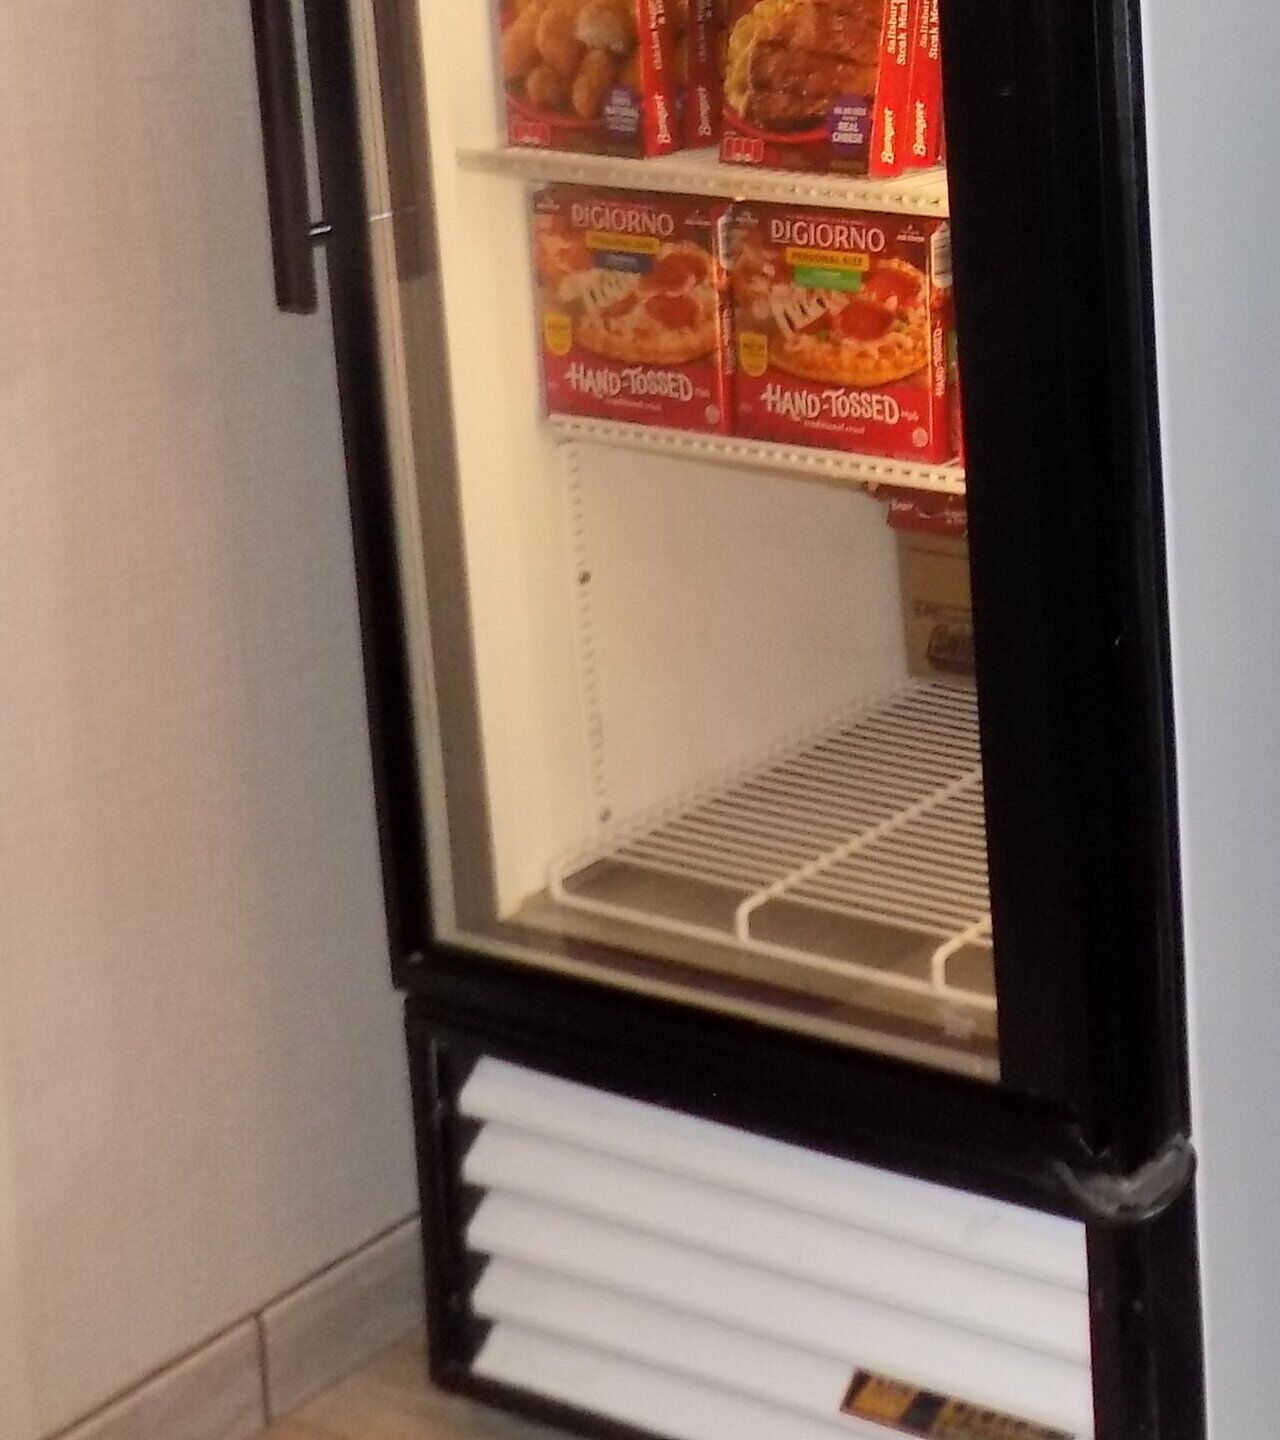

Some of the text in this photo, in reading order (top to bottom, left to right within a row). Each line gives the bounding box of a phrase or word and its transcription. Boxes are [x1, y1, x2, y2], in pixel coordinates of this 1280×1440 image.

[897, 32, 907, 66] Steak
[928, 25, 938, 60] Steak
[655, 93, 672, 144] Banquet
[881, 106, 897, 164] Banquet
[913, 99, 927, 157] Banquet
[564, 361, 695, 402] HAND-TOSSED
[760, 382, 900, 425] HAND-TOSSED
